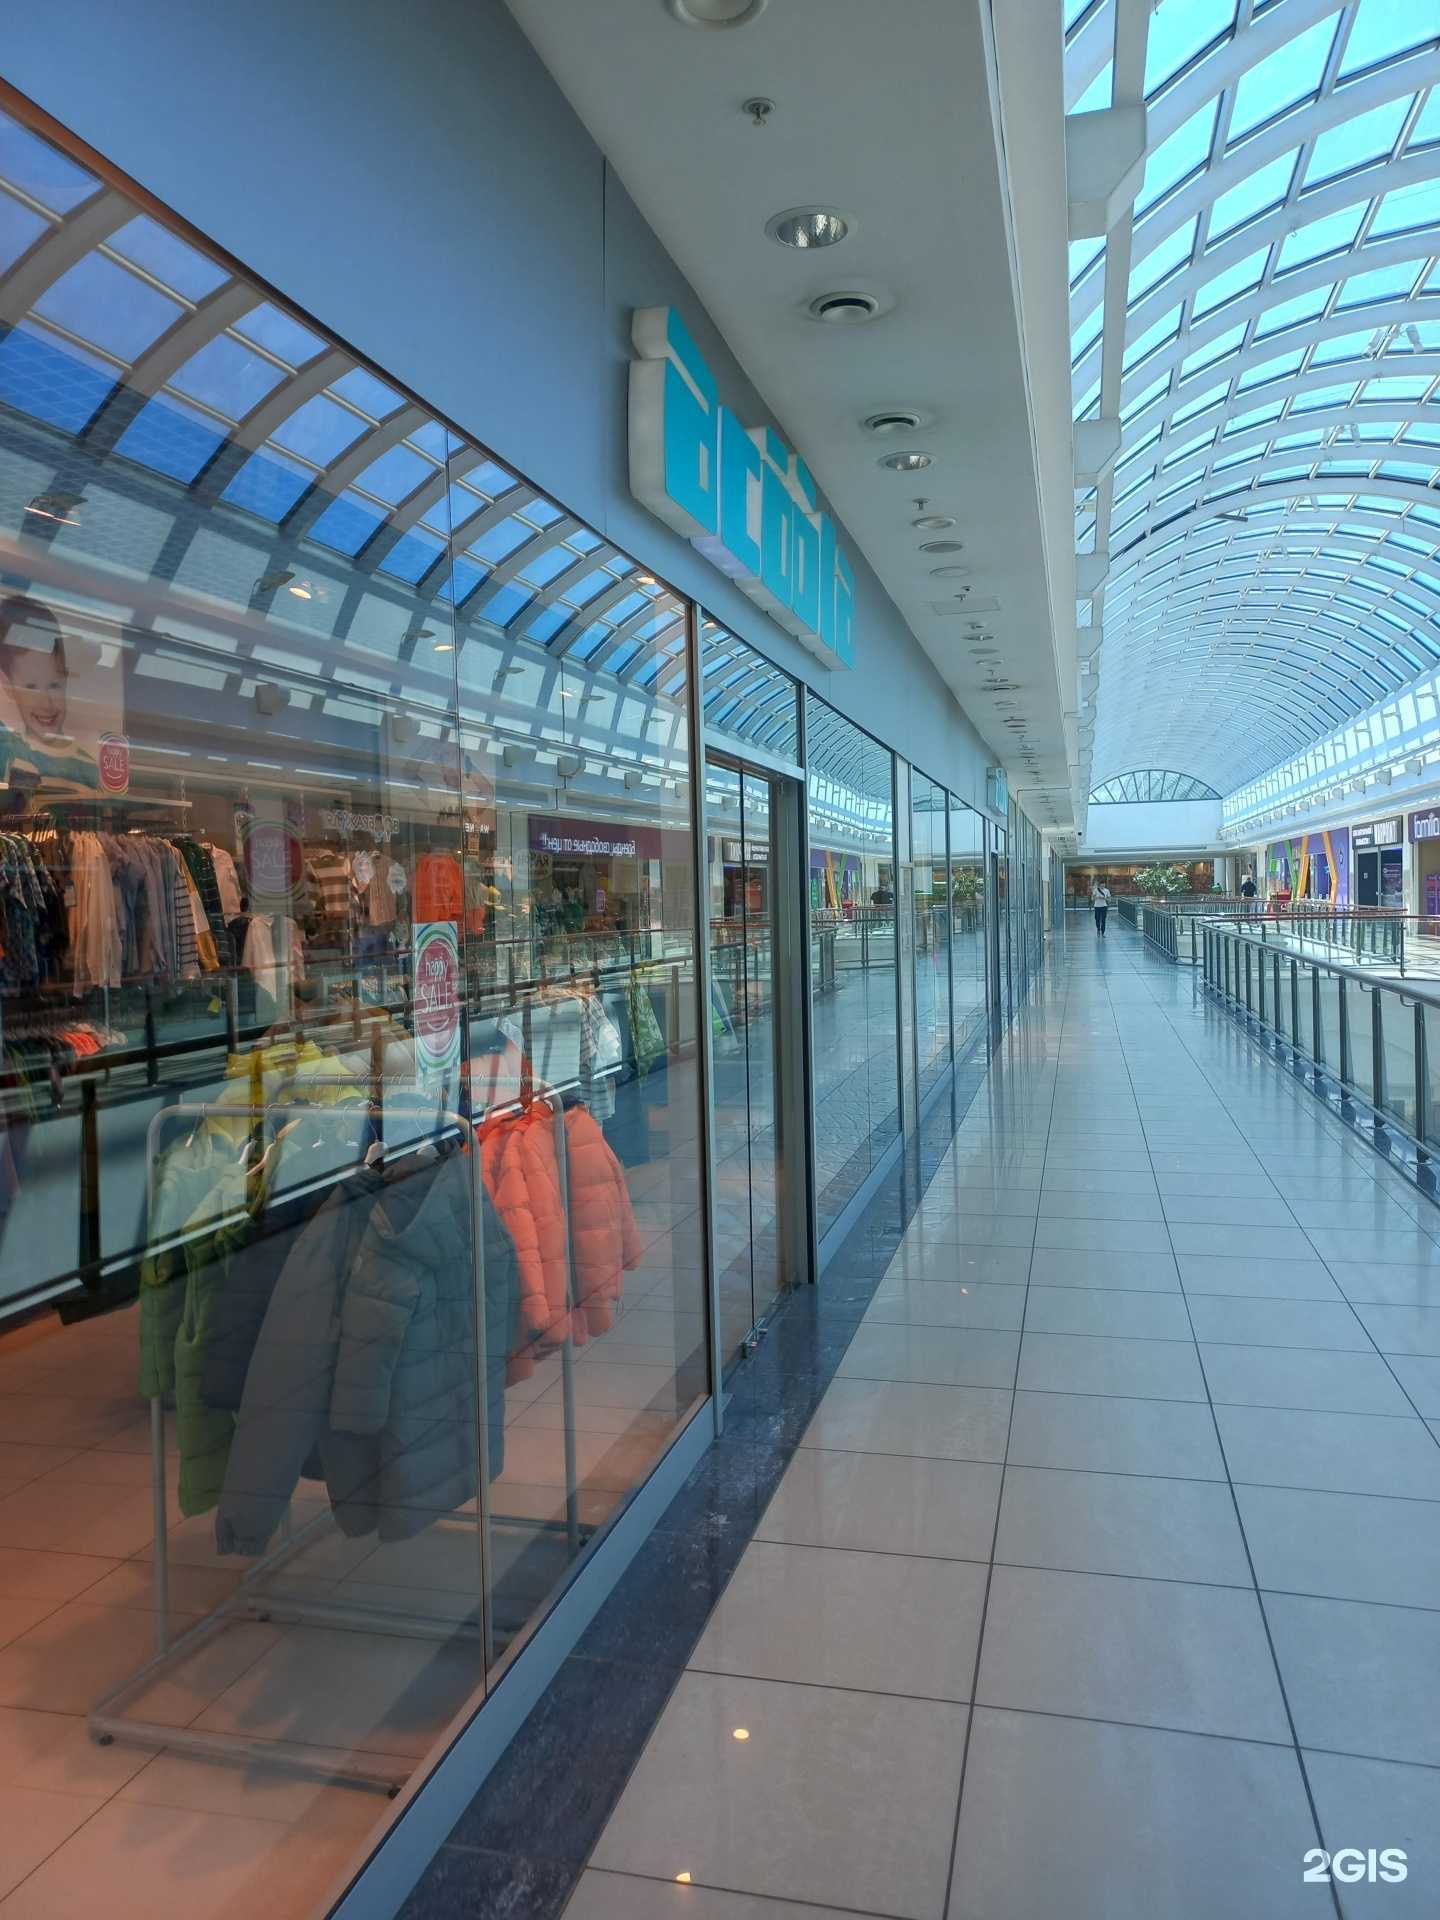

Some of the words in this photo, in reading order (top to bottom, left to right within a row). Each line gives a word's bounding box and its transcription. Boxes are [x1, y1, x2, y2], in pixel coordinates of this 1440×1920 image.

[103, 755, 125, 772] SALE
[251, 850, 293, 868] SALE
[420, 983, 453, 1014] SALE
